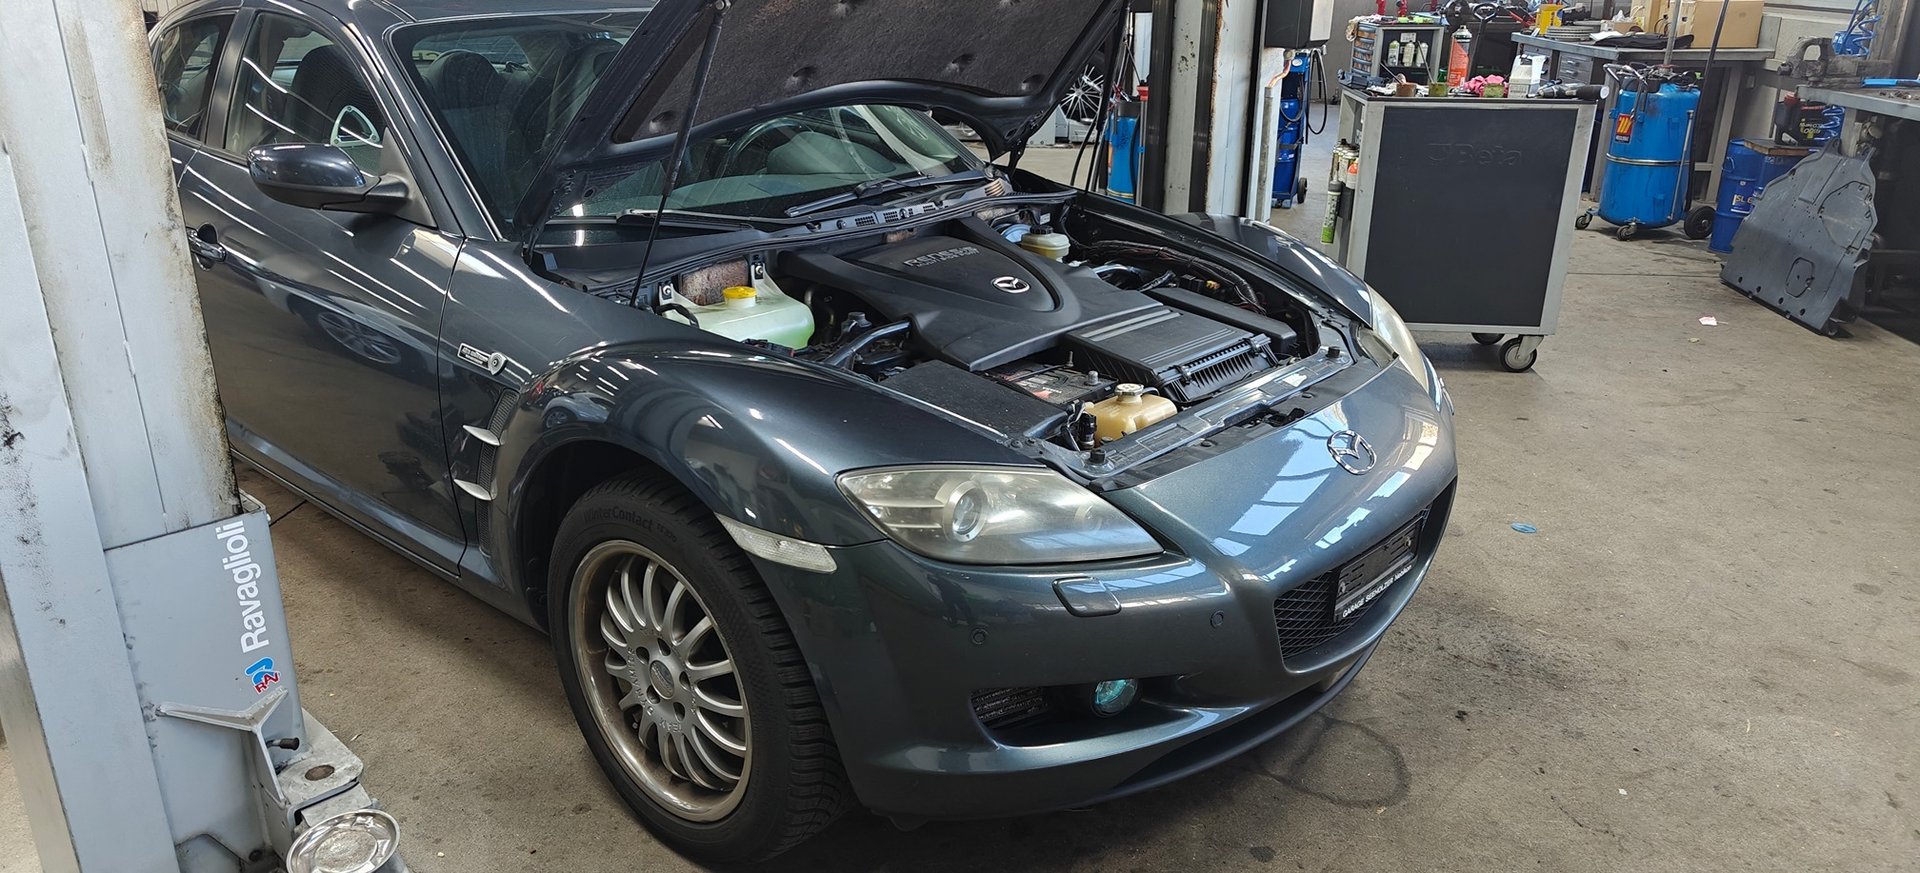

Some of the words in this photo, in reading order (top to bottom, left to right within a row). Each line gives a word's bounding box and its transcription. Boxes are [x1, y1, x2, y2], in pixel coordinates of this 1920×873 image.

[1453, 143, 1522, 166] Beta
[583, 506, 653, 532] WinterContact
[215, 519, 270, 654] Ravaglioli
[1342, 597, 1365, 618] GARAGE
[254, 671, 281, 695] RAV
